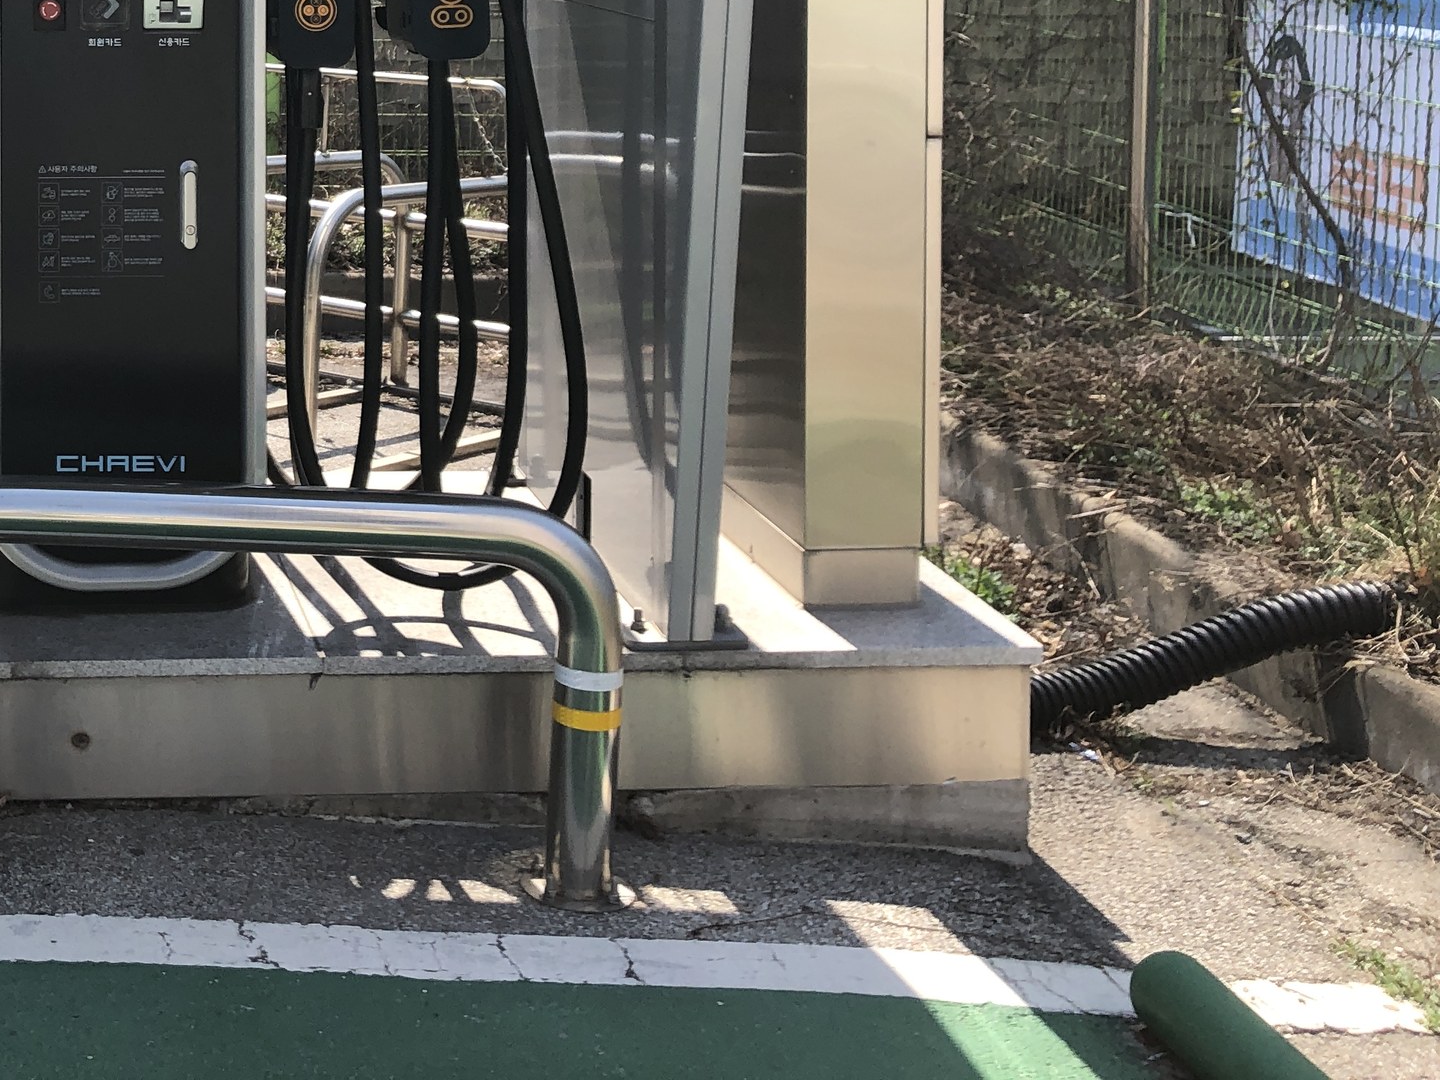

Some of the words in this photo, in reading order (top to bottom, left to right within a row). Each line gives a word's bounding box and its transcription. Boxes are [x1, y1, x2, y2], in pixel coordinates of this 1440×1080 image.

[158, 37, 191, 47] 신용카드
[47, 164, 69, 174] 사용자
[70, 164, 98, 174] 주의사항
[55, 455, 186, 472] CHAEVI
